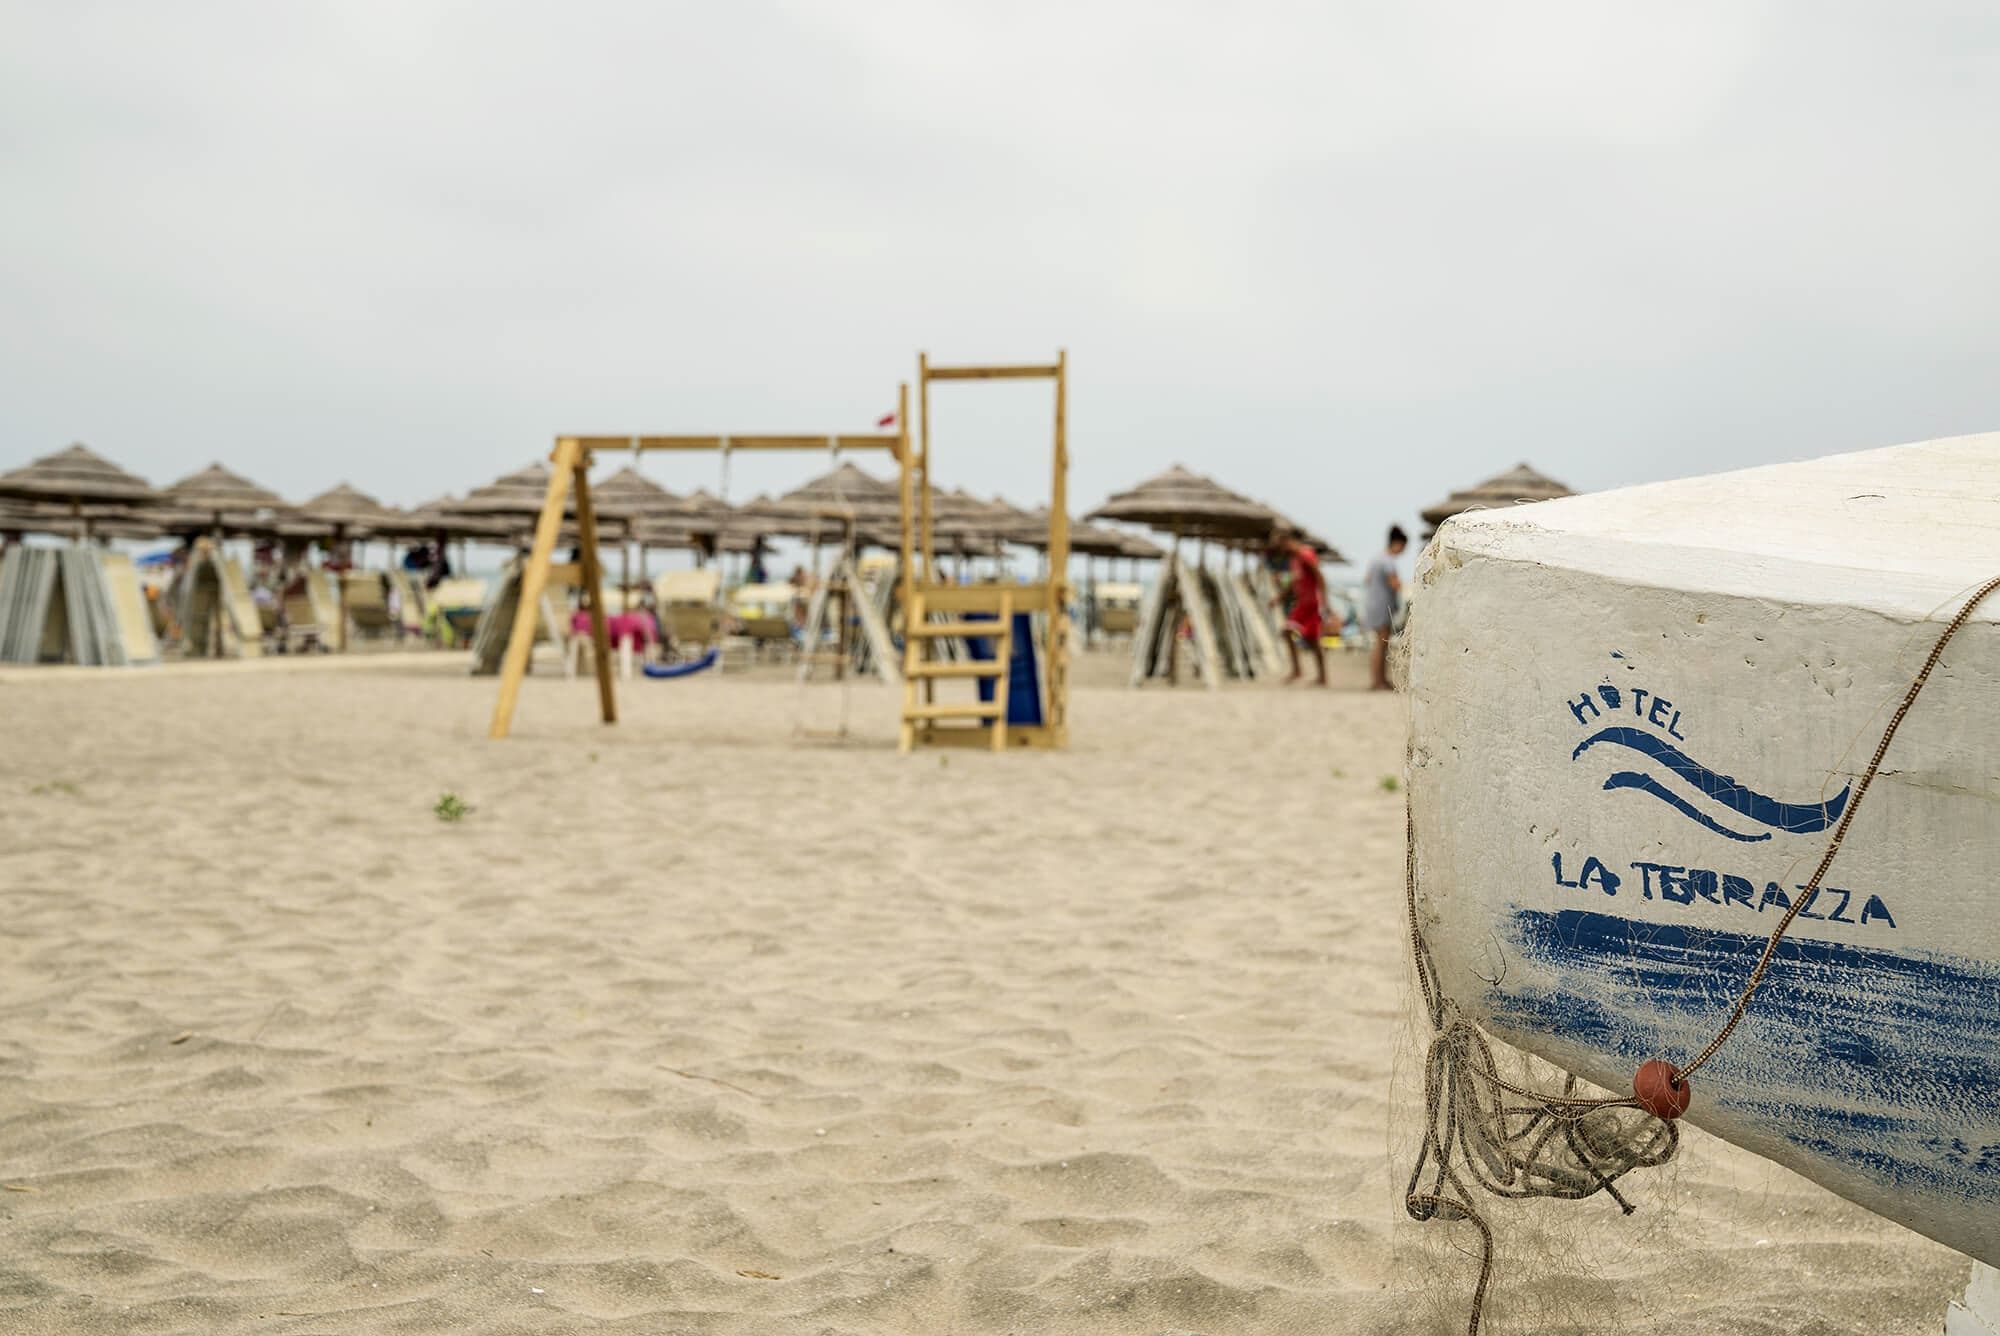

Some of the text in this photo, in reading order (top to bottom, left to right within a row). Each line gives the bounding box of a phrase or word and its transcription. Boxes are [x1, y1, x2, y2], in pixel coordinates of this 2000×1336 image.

[1567, 684, 1685, 741] HOTEL
[1552, 851, 1897, 929] LA TERRAZZA
